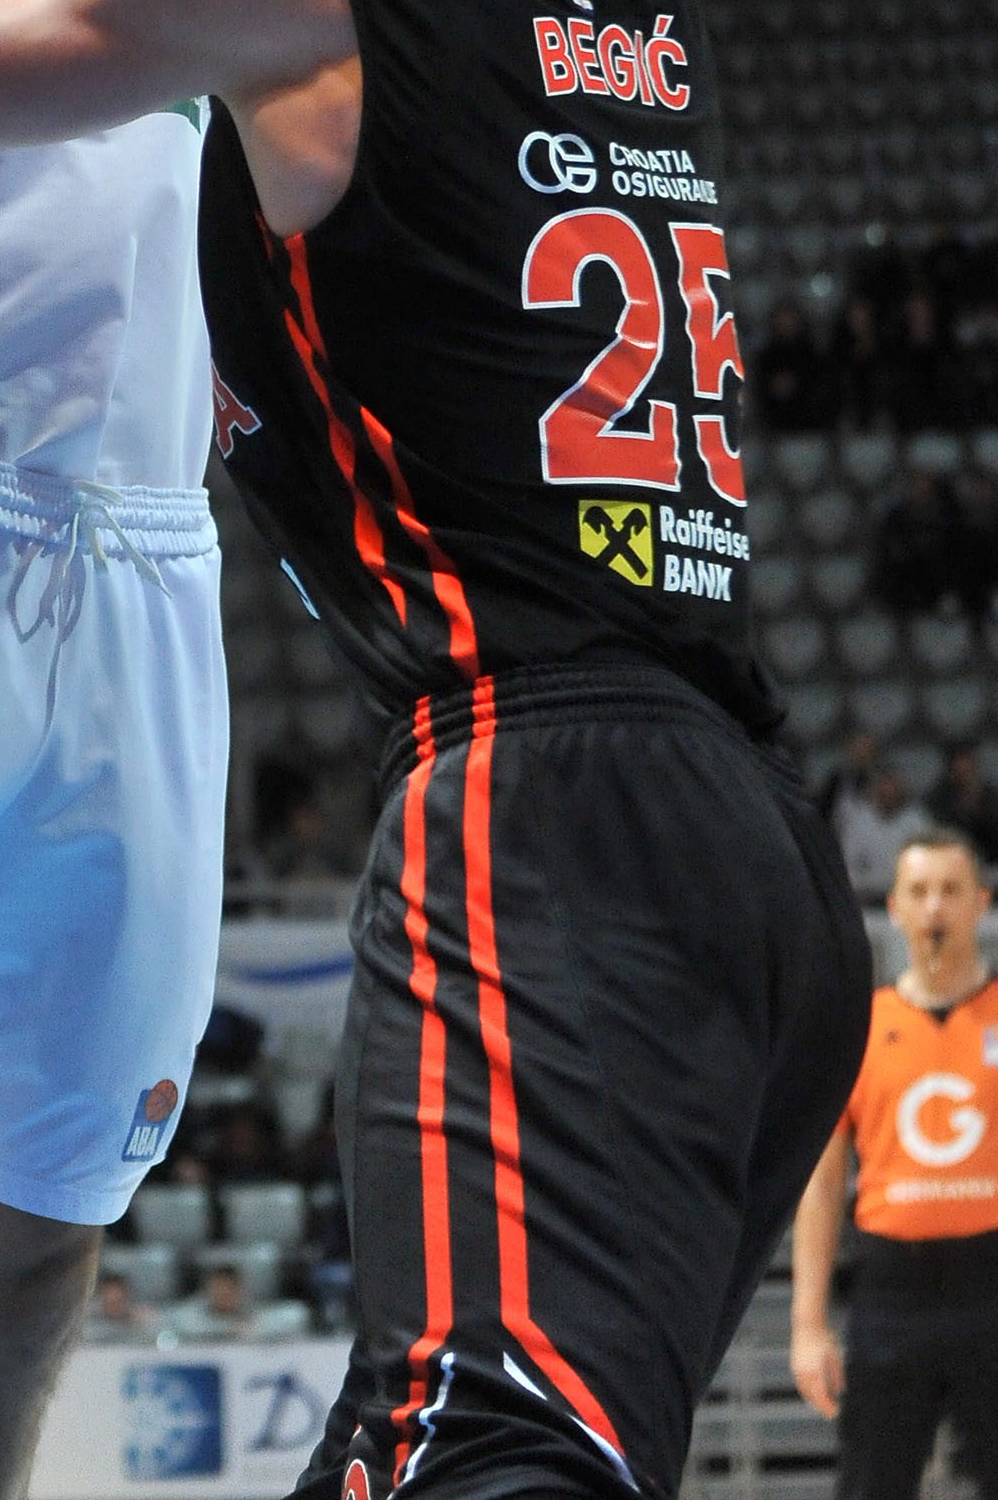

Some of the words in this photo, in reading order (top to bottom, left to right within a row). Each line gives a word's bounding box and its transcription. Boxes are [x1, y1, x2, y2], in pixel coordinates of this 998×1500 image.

[533, 15, 691, 112] BEGIĆ
[609, 141, 695, 173] CROATIA
[522, 206, 748, 507] 25
[663, 554, 733, 602] BANK
[126, 1126, 160, 1156] ABA
[896, 1072, 987, 1168] G
